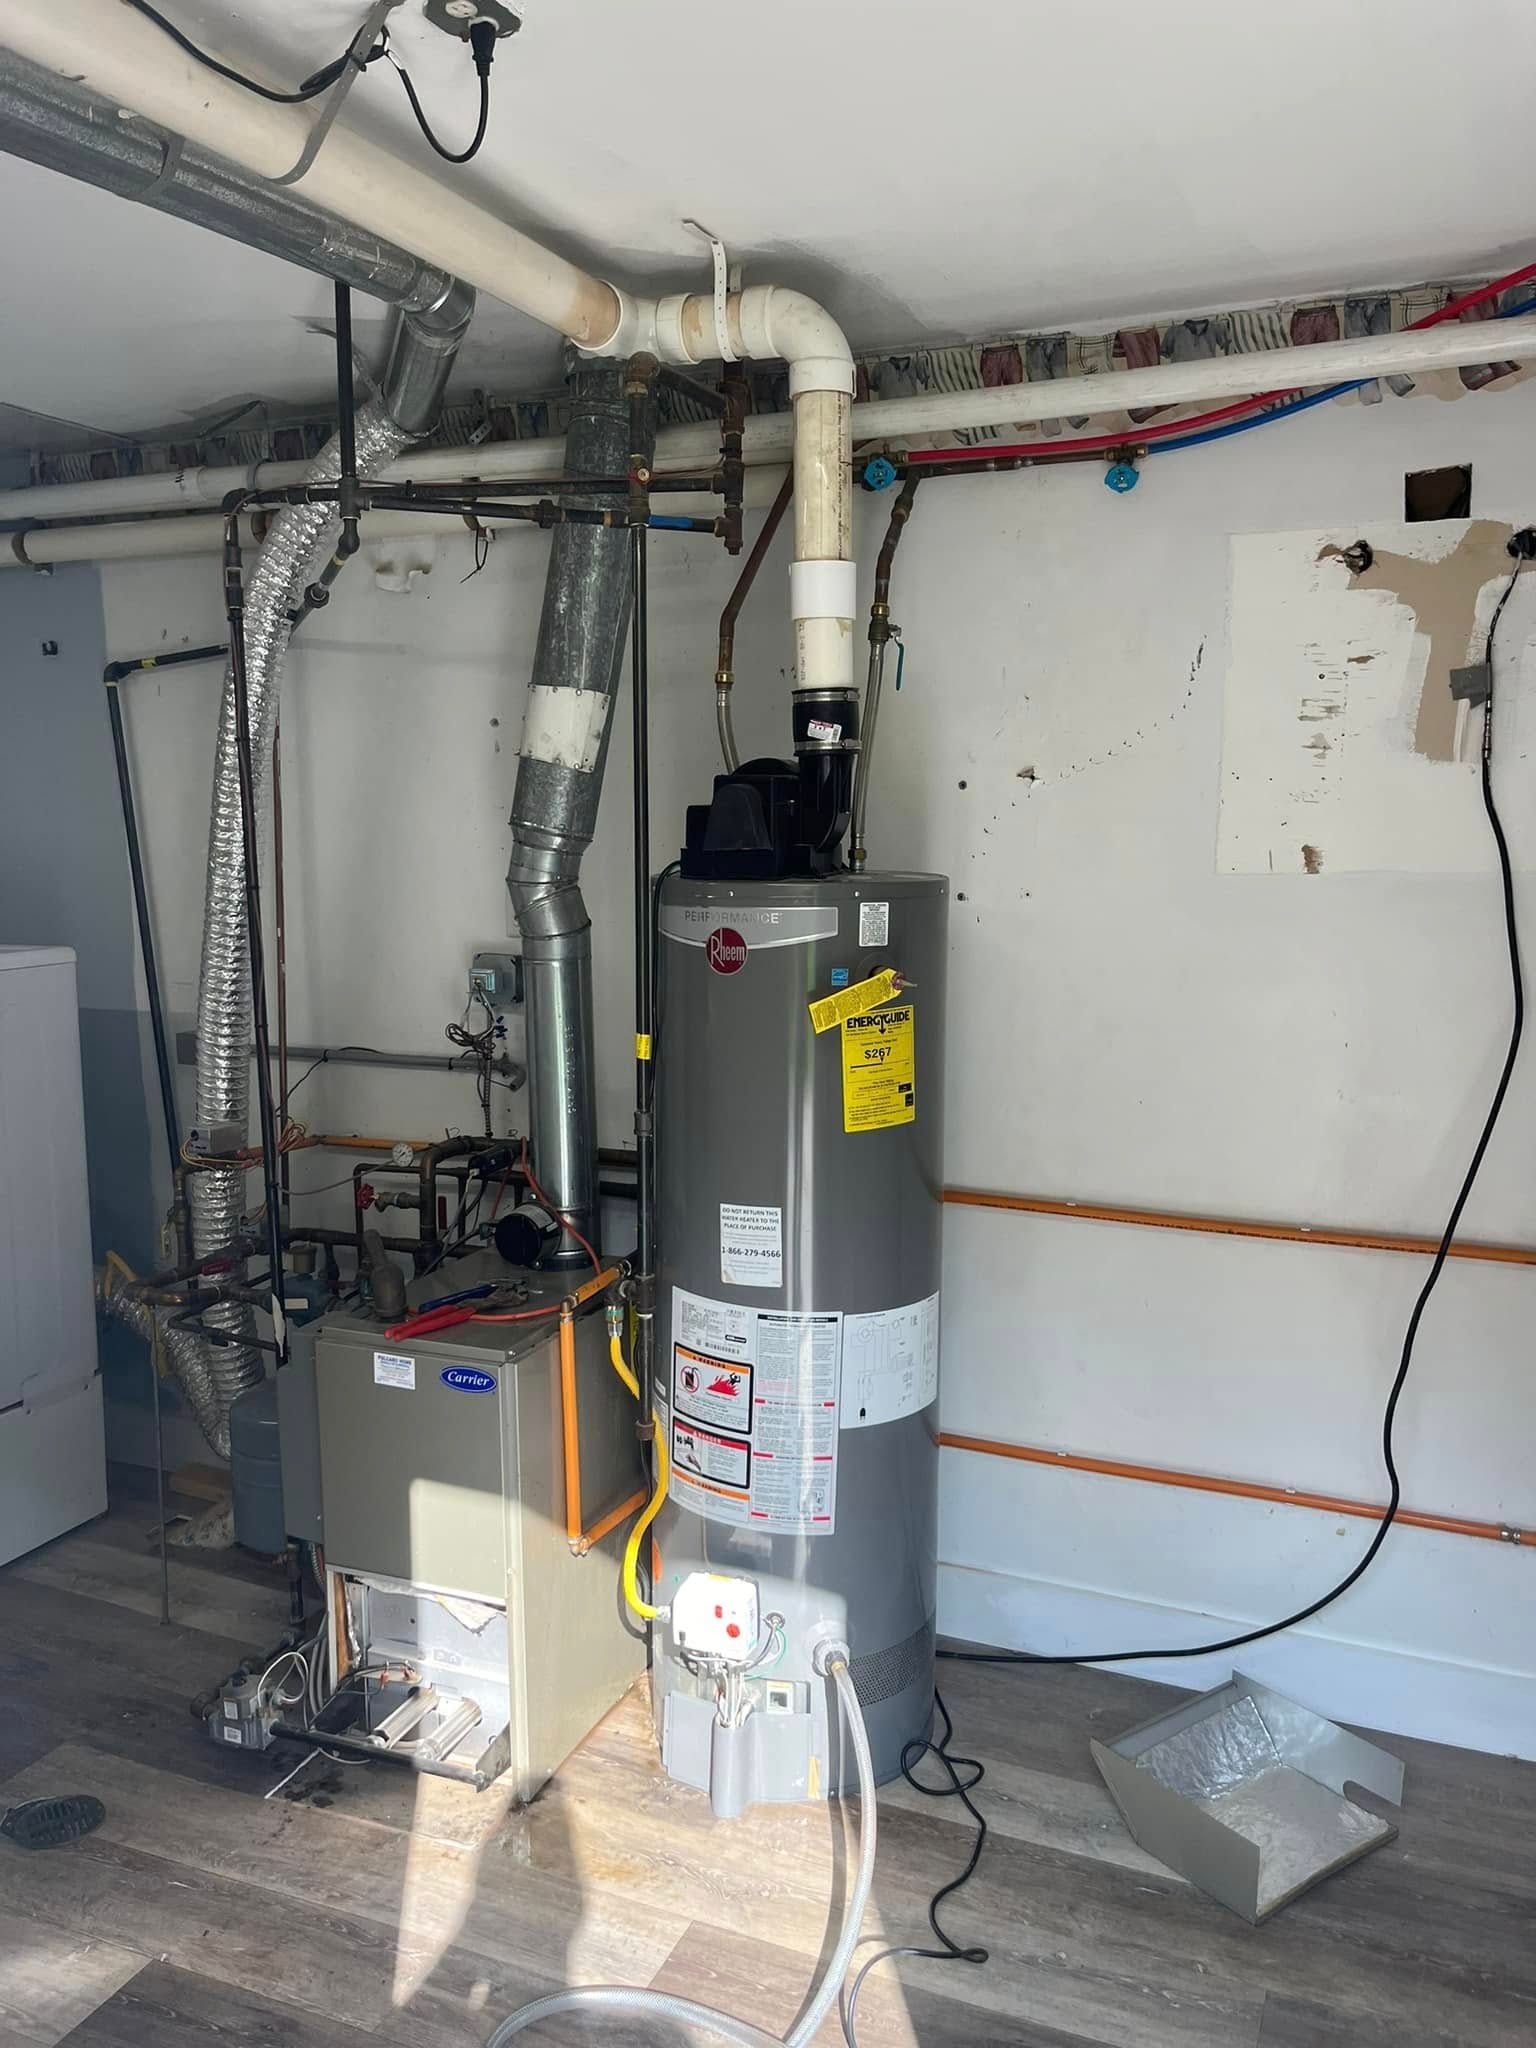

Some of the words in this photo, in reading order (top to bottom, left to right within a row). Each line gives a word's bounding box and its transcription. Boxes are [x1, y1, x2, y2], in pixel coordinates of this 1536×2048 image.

[685, 910, 780, 925] PERFORMANCE
[710, 928, 745, 967] Rheem
[847, 1010, 910, 1030] ENERGYGUIDE
[722, 1246, 781, 1258] 1-866-279-4566
[447, 1371, 490, 1387] Carrier
